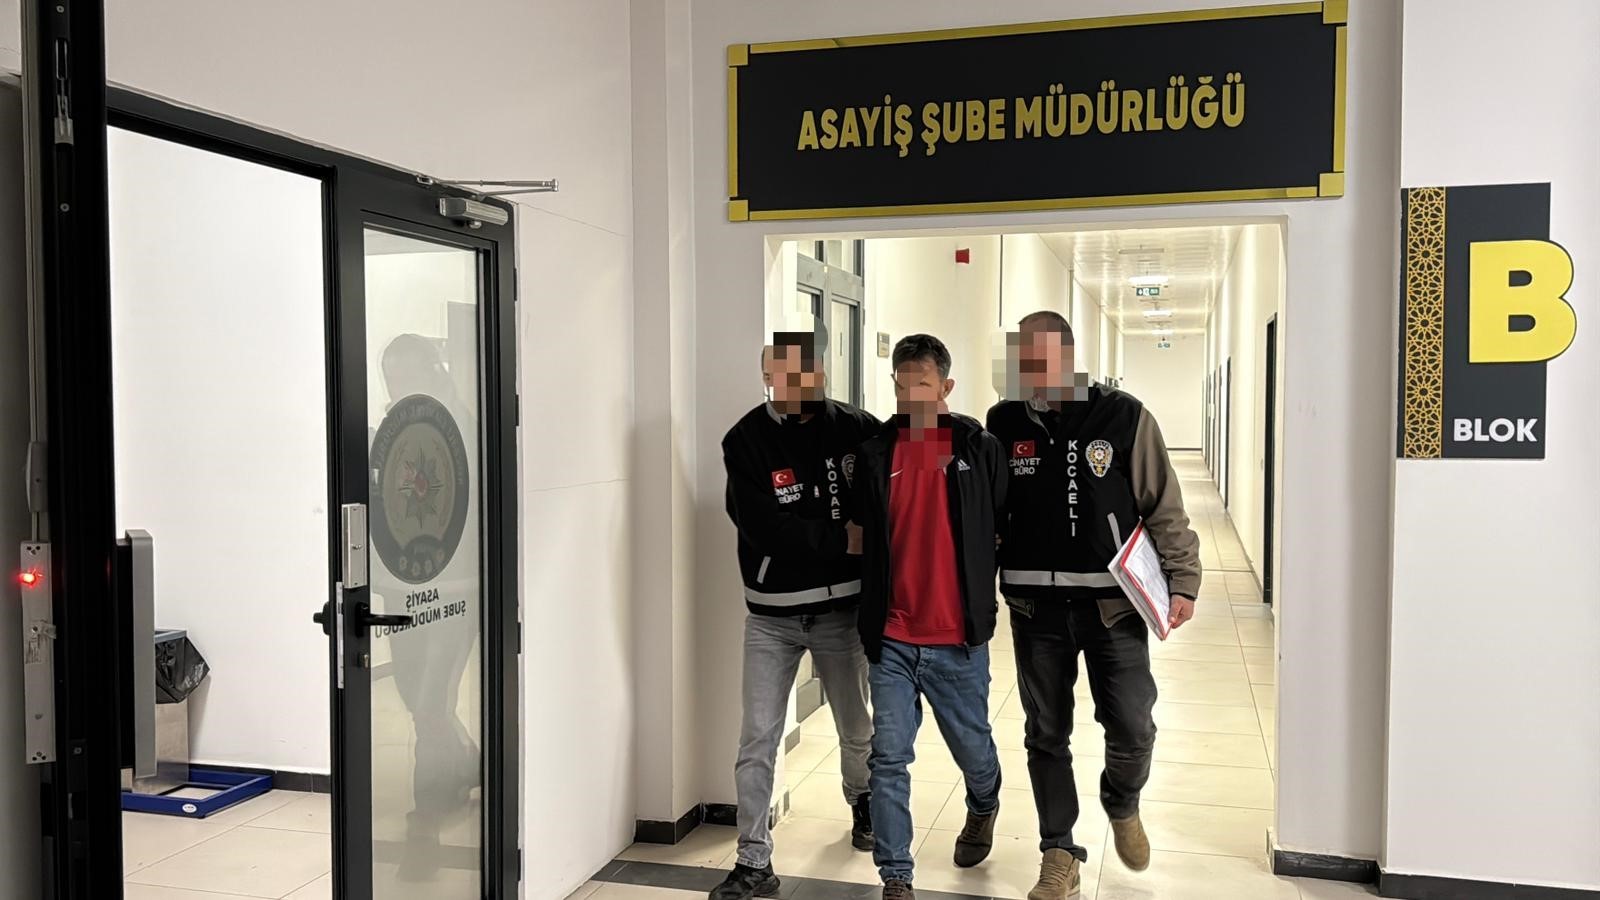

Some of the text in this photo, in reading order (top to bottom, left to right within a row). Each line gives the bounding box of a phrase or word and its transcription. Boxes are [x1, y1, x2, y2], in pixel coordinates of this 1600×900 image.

[797, 72, 1245, 158] ASAYİŞ ŞUBE MÜDÜRLÜĞÜ
[1469, 239, 1577, 364] B
[1453, 417, 1538, 443] BLOK
[825, 457, 841, 520] KOCAE
[1014, 465, 1036, 476] BÜRO
